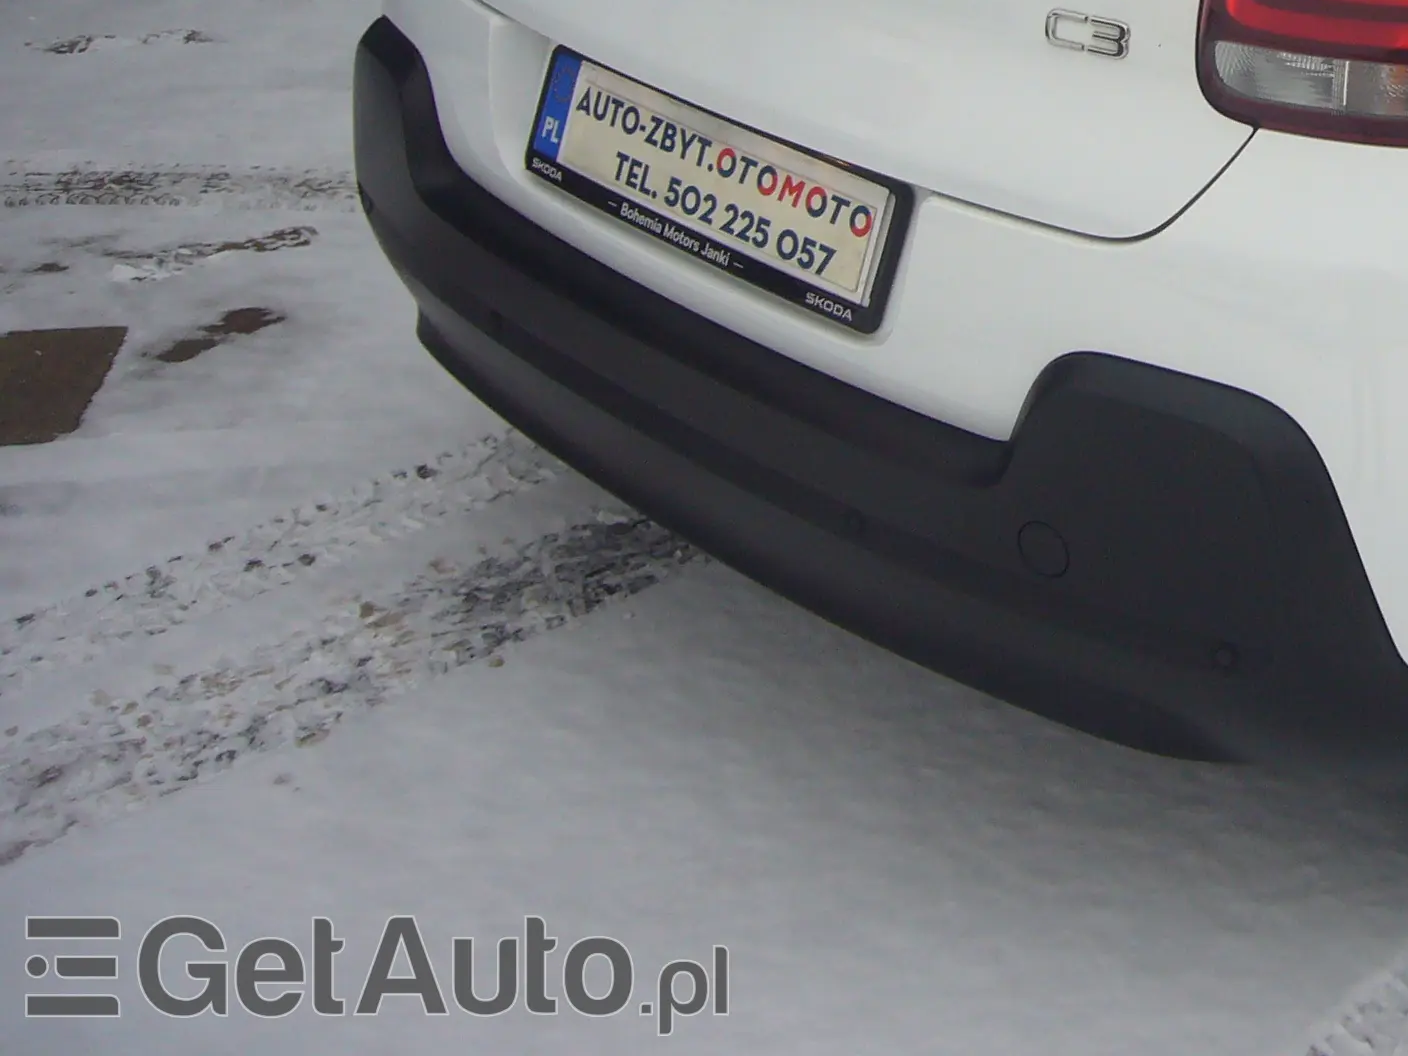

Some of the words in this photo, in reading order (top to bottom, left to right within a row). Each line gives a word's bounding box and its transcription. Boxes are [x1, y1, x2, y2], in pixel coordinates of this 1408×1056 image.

[1044, 7, 1132, 60] C3
[541, 115, 560, 144] PL
[576, 86, 873, 238] AUTO-ZBYT.OTOMOTO
[615, 151, 657, 200] TEL.
[663, 175, 718, 225] 502
[719, 202, 772, 249] 225
[775, 228, 838, 276] 057
[619, 202, 662, 235] Bohemia
[663, 222, 701, 252] Motors
[700, 244, 730, 268] Janki
